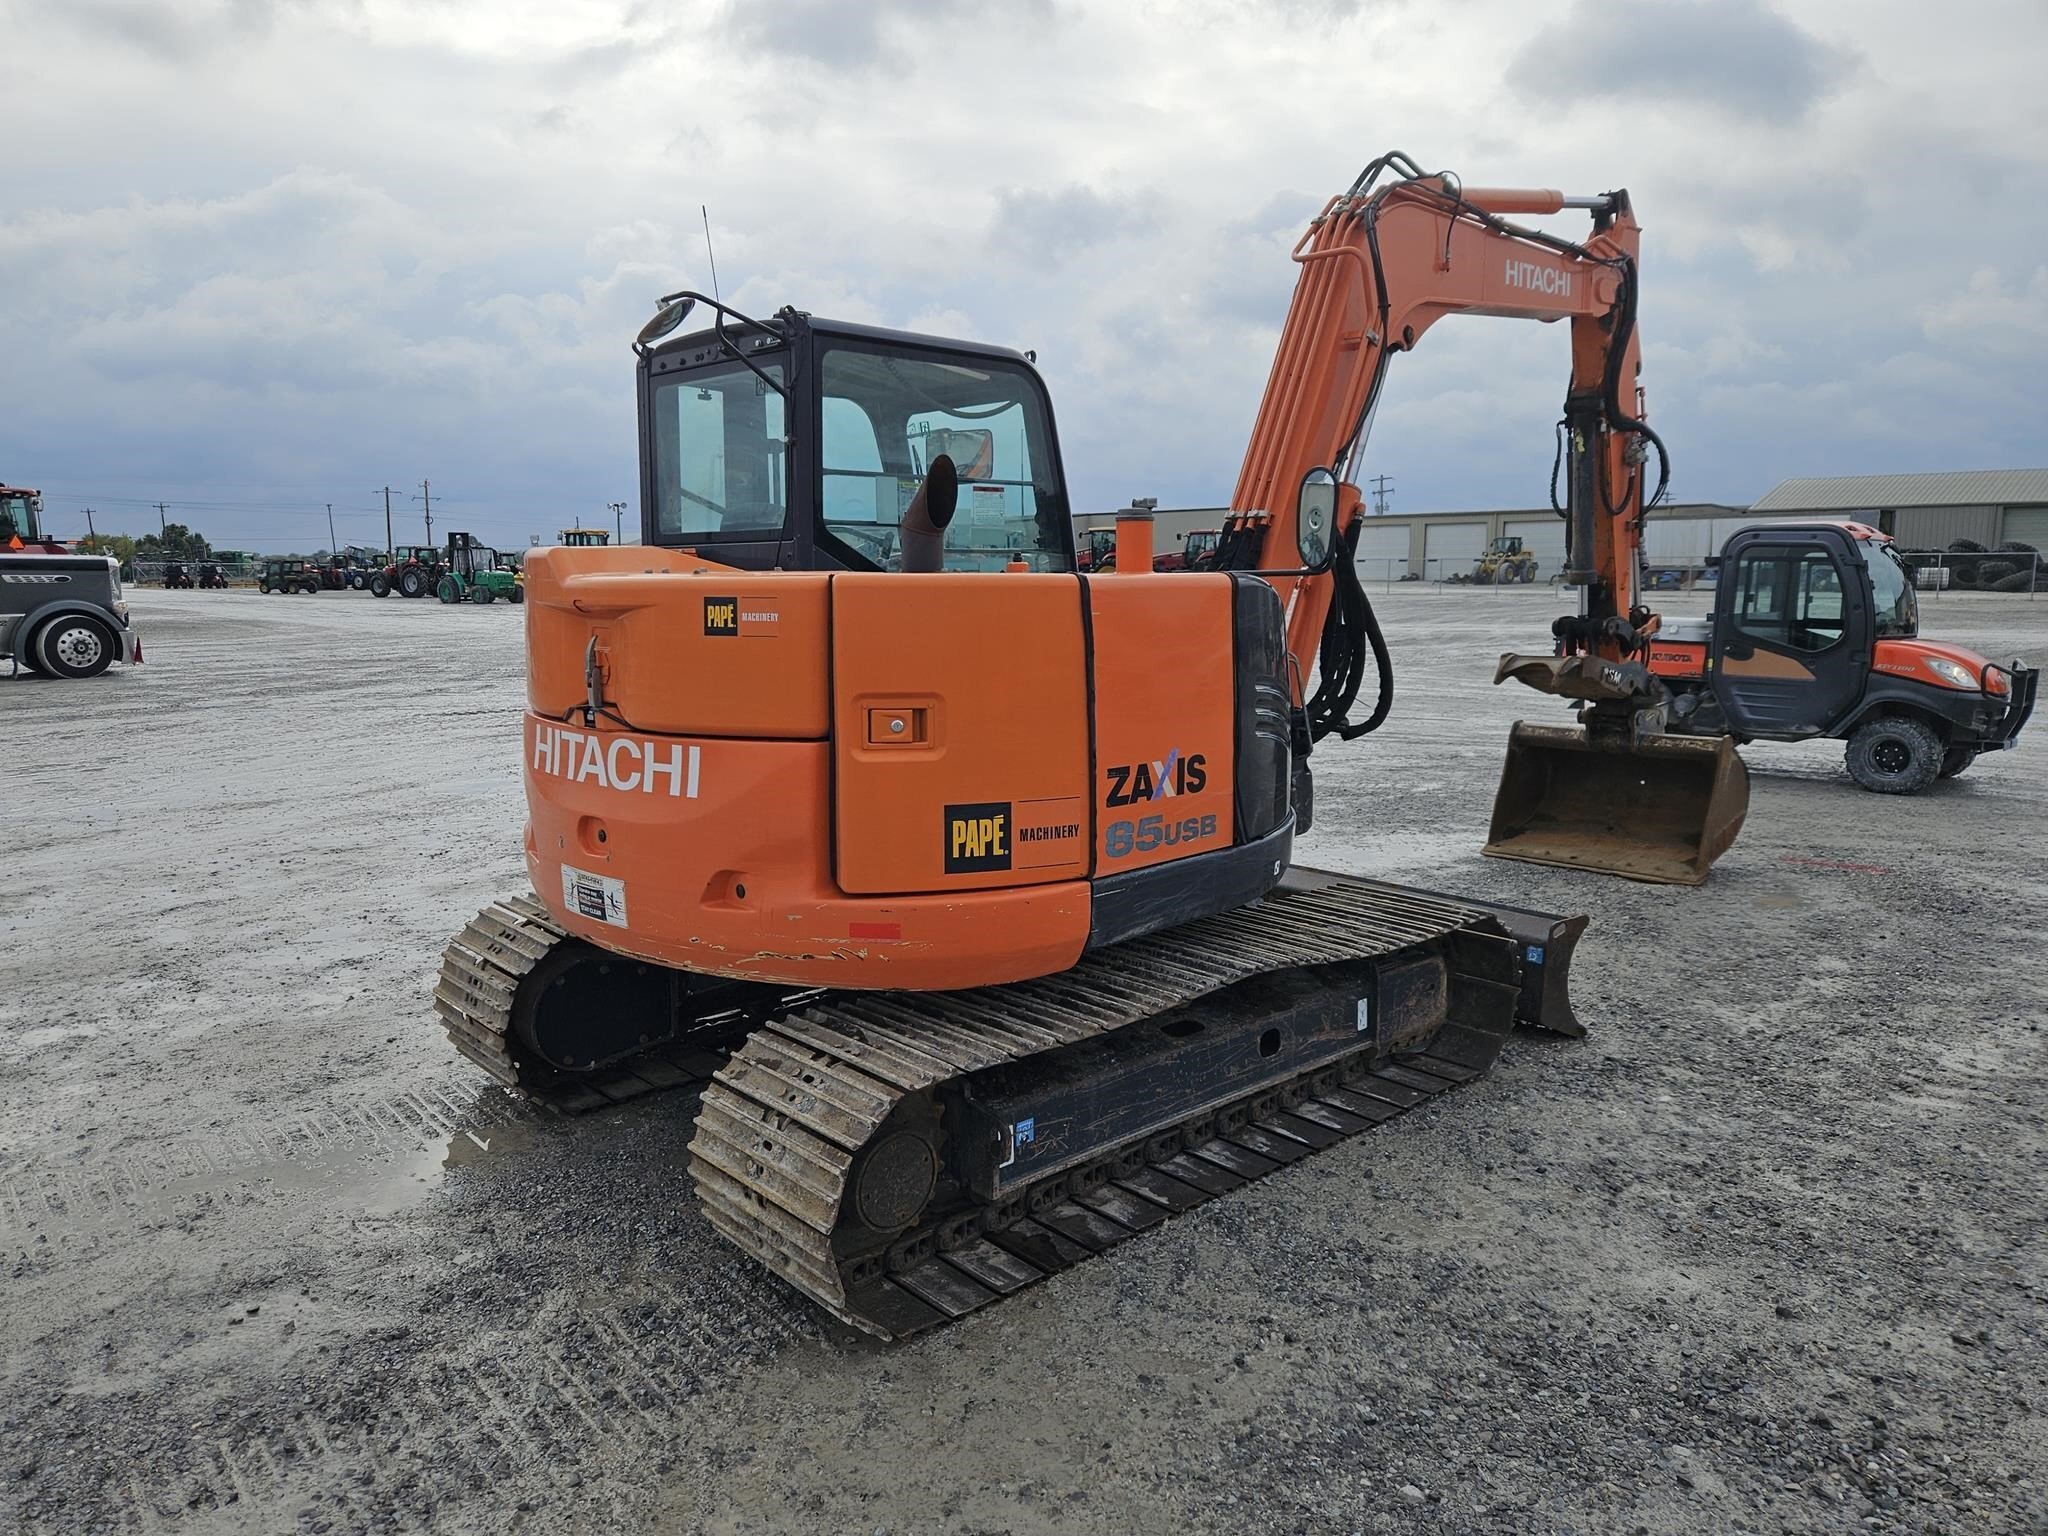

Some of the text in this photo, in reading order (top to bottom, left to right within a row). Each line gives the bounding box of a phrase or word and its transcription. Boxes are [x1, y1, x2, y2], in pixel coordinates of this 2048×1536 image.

[1504, 258, 1571, 297] HITACHI
[741, 612, 779, 622] MACHINERY
[533, 723, 701, 799] HITACHI
[1106, 748, 1207, 808] ZAXIS
[952, 814, 1080, 858] PAPÉ MACHINERY
